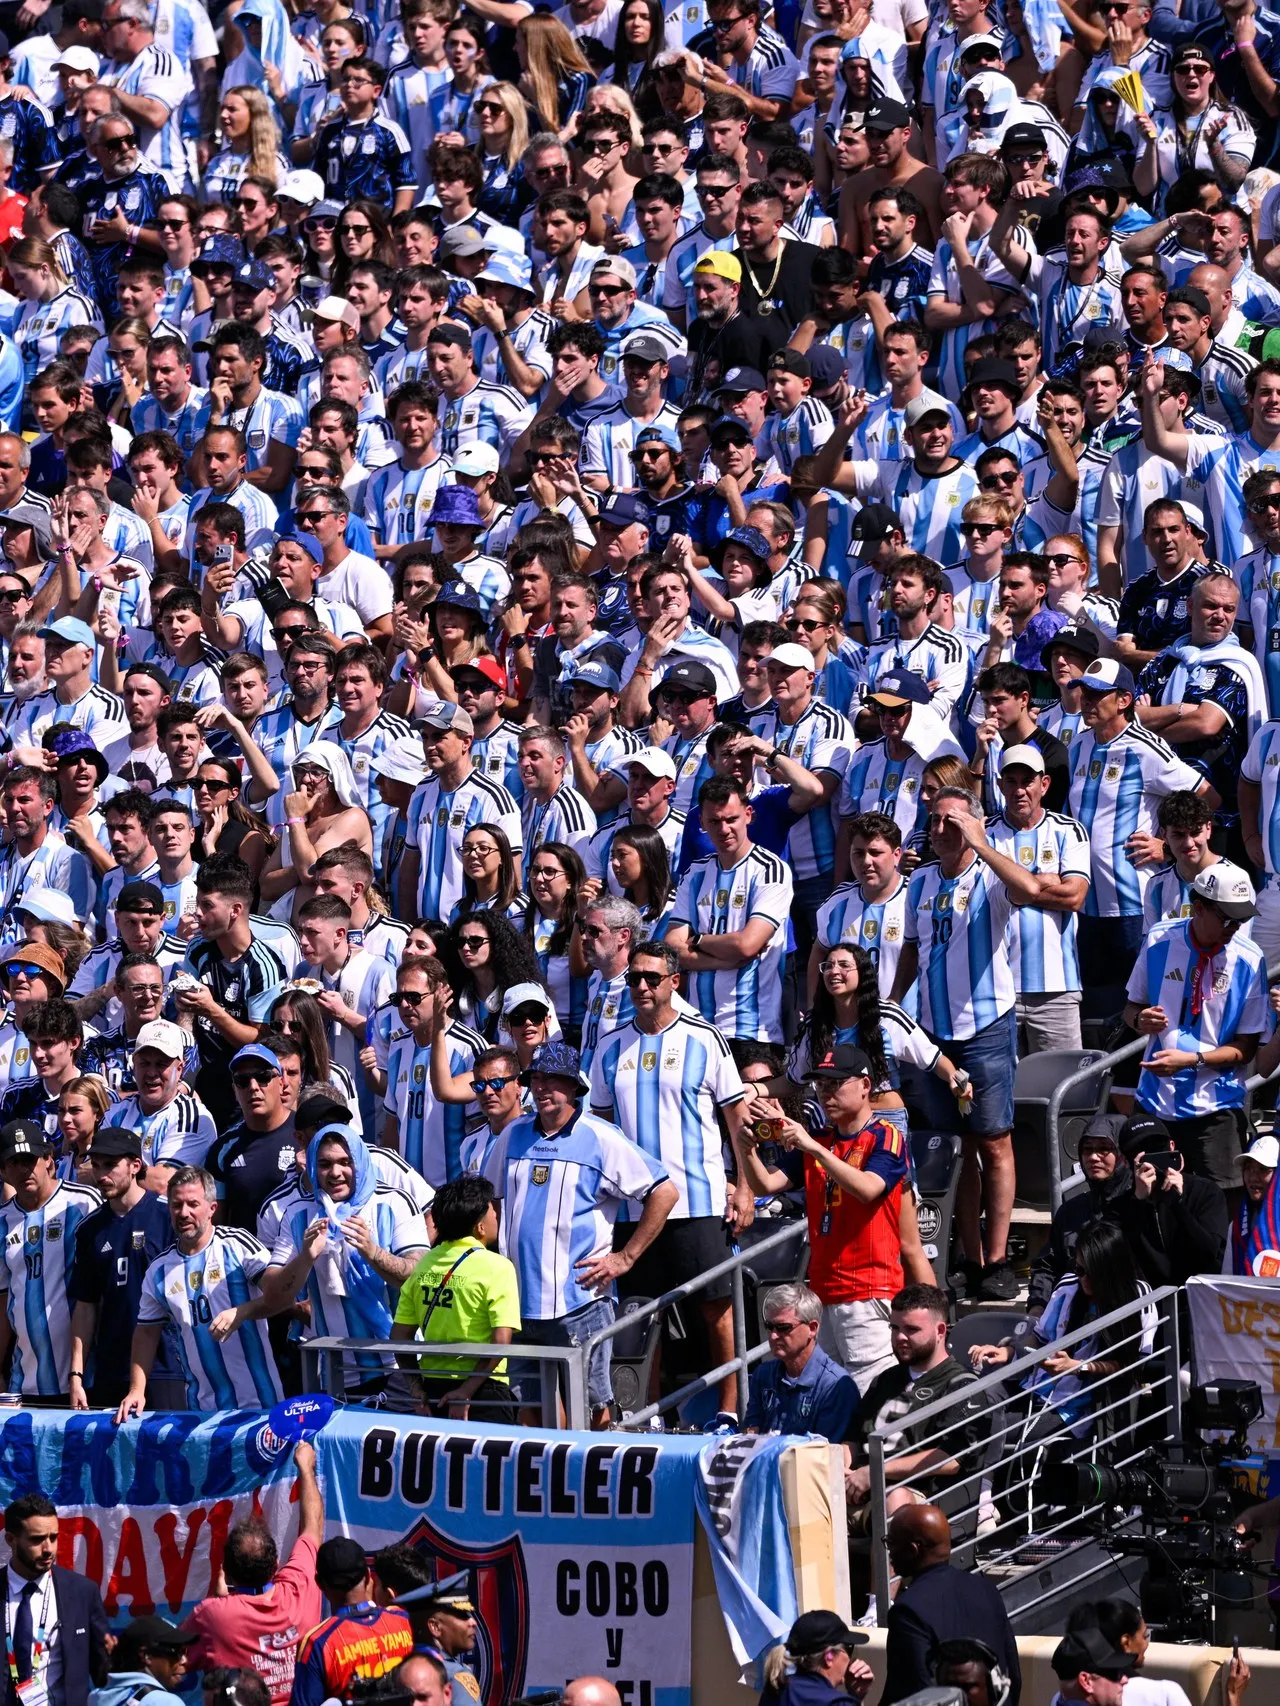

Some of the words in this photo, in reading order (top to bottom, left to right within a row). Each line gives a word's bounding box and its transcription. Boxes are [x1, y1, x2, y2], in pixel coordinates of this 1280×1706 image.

[397, 512, 416, 534] 10
[931, 917, 953, 945] 10
[1081, 1057, 1092, 1068] 22
[407, 1089, 425, 1120] 10
[532, 1145, 559, 1153] Reebok
[929, 1137, 940, 1148] 22
[24, 1251, 43, 1281] 10
[116, 1256, 129, 1287] 9
[421, 1286, 454, 1309] 112
[187, 1294, 214, 1328] 10
[284, 1404, 321, 1417] ULTRA
[360, 1427, 660, 1517] BUTTELER
[556, 1559, 670, 1617] COBO
[259, 1626, 300, 1652] F&E
[335, 1637, 381, 1666] LAMINE
[251, 1655, 263, 1665] LED
[263, 1671, 296, 1687] WRAPPIN
